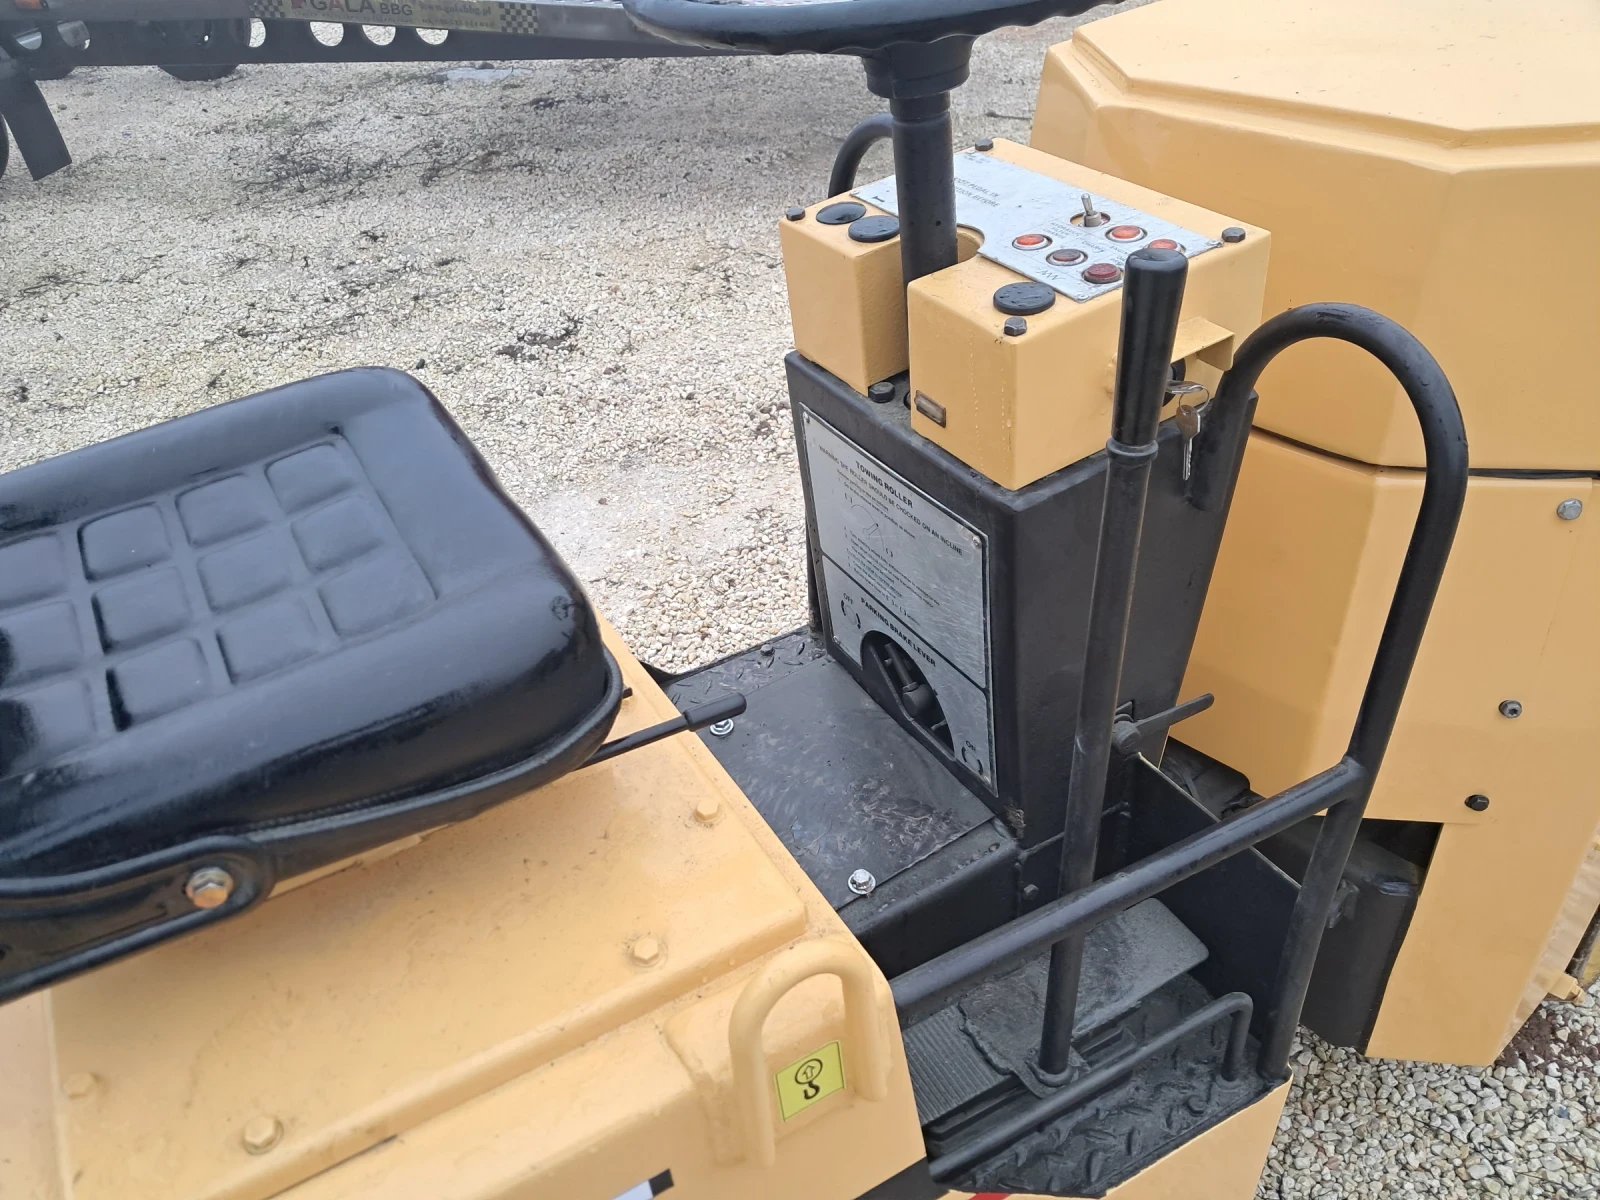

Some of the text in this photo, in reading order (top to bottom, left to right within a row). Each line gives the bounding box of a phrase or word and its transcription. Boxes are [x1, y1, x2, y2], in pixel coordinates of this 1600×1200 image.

[310, 0, 375, 13] GALA
[380, 3, 413, 16] BBG
[855, 460, 884, 487] TOWING
[884, 481, 914, 509] ROLLER
[849, 468, 868, 487] ROLLER
[868, 482, 888, 501] SHOULD
[895, 503, 922, 526] CHOCKED
[922, 522, 931, 533] ON
[940, 535, 963, 556] INCLINE
[843, 592, 854, 605] OFF
[861, 596, 936, 667] PARKING BRAKE LEVER
